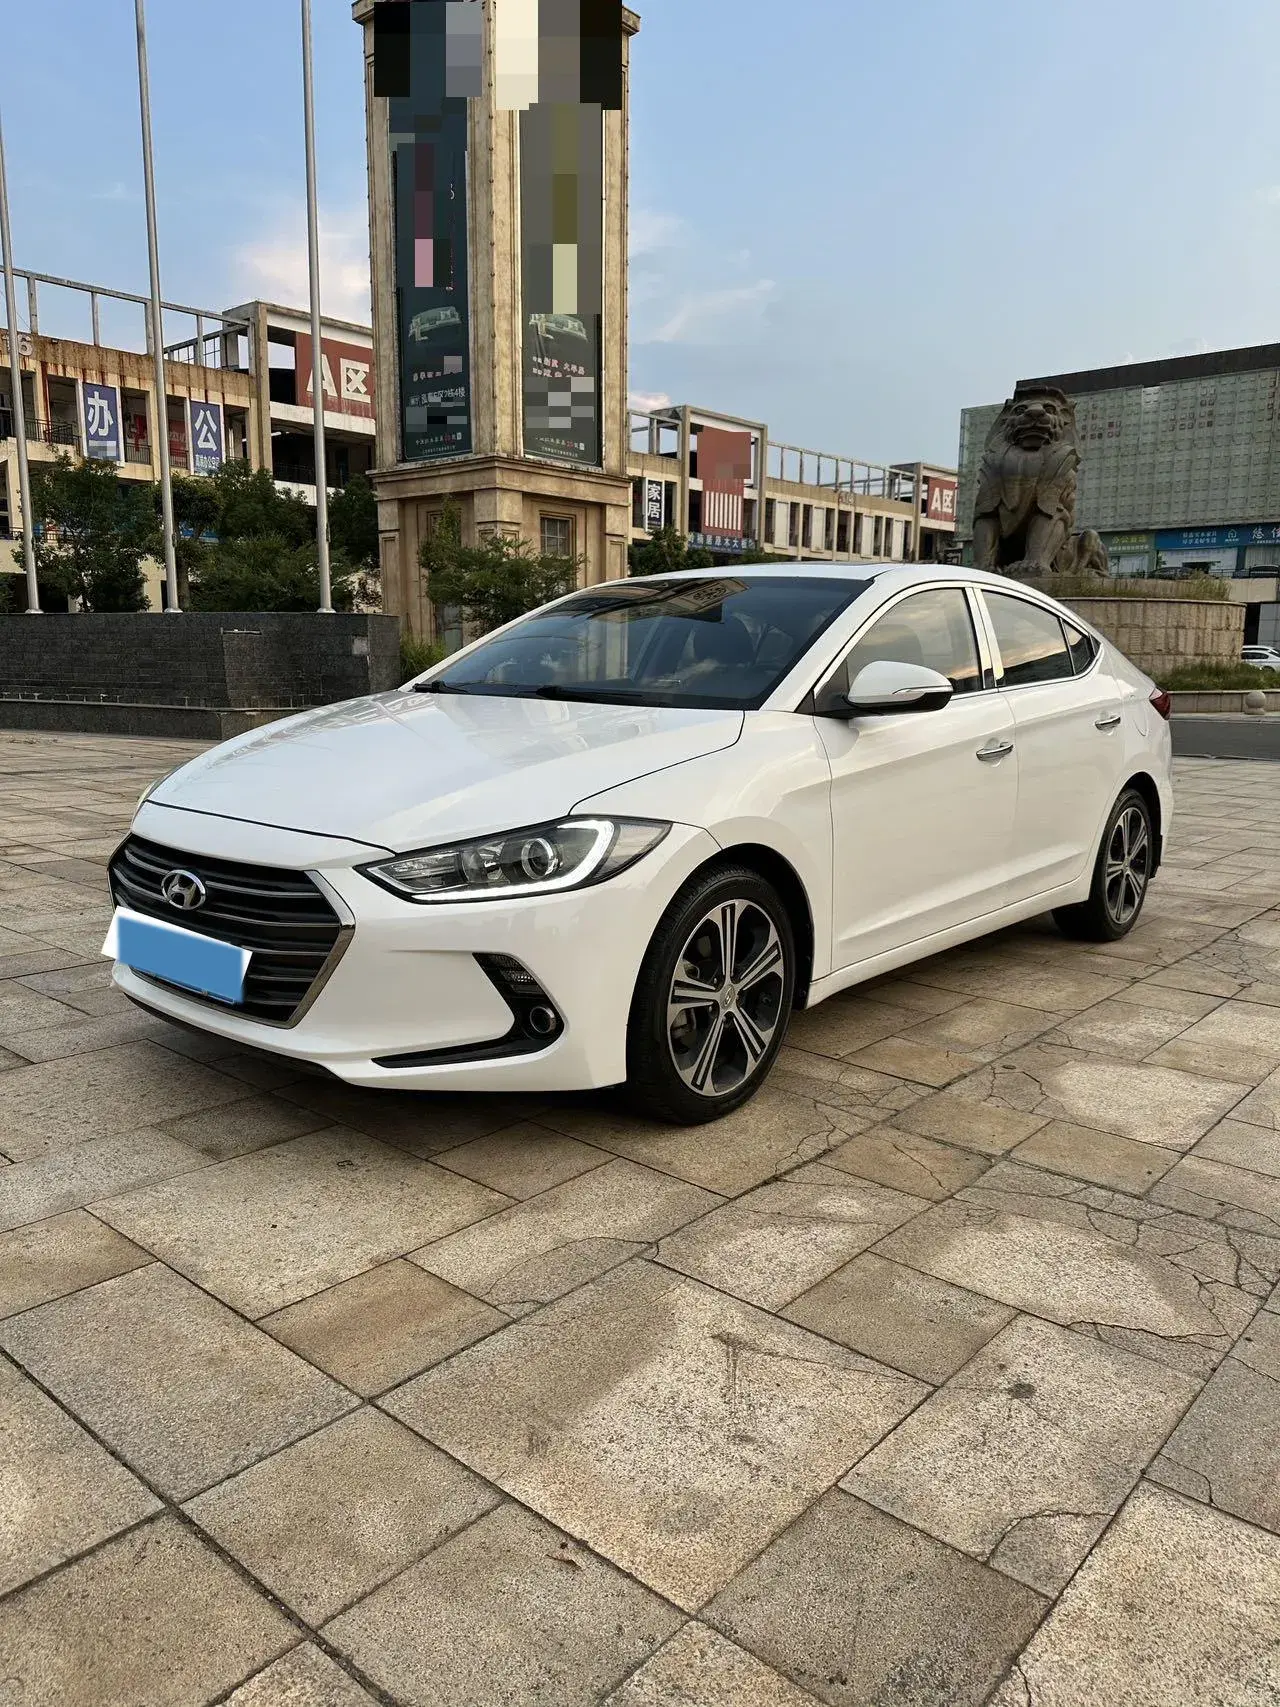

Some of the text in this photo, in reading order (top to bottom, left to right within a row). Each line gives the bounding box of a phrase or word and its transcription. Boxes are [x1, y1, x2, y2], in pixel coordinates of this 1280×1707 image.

[87, 391, 218, 452] 办 公
[647, 484, 661, 519] 家居
[931, 487, 954, 513] A区
